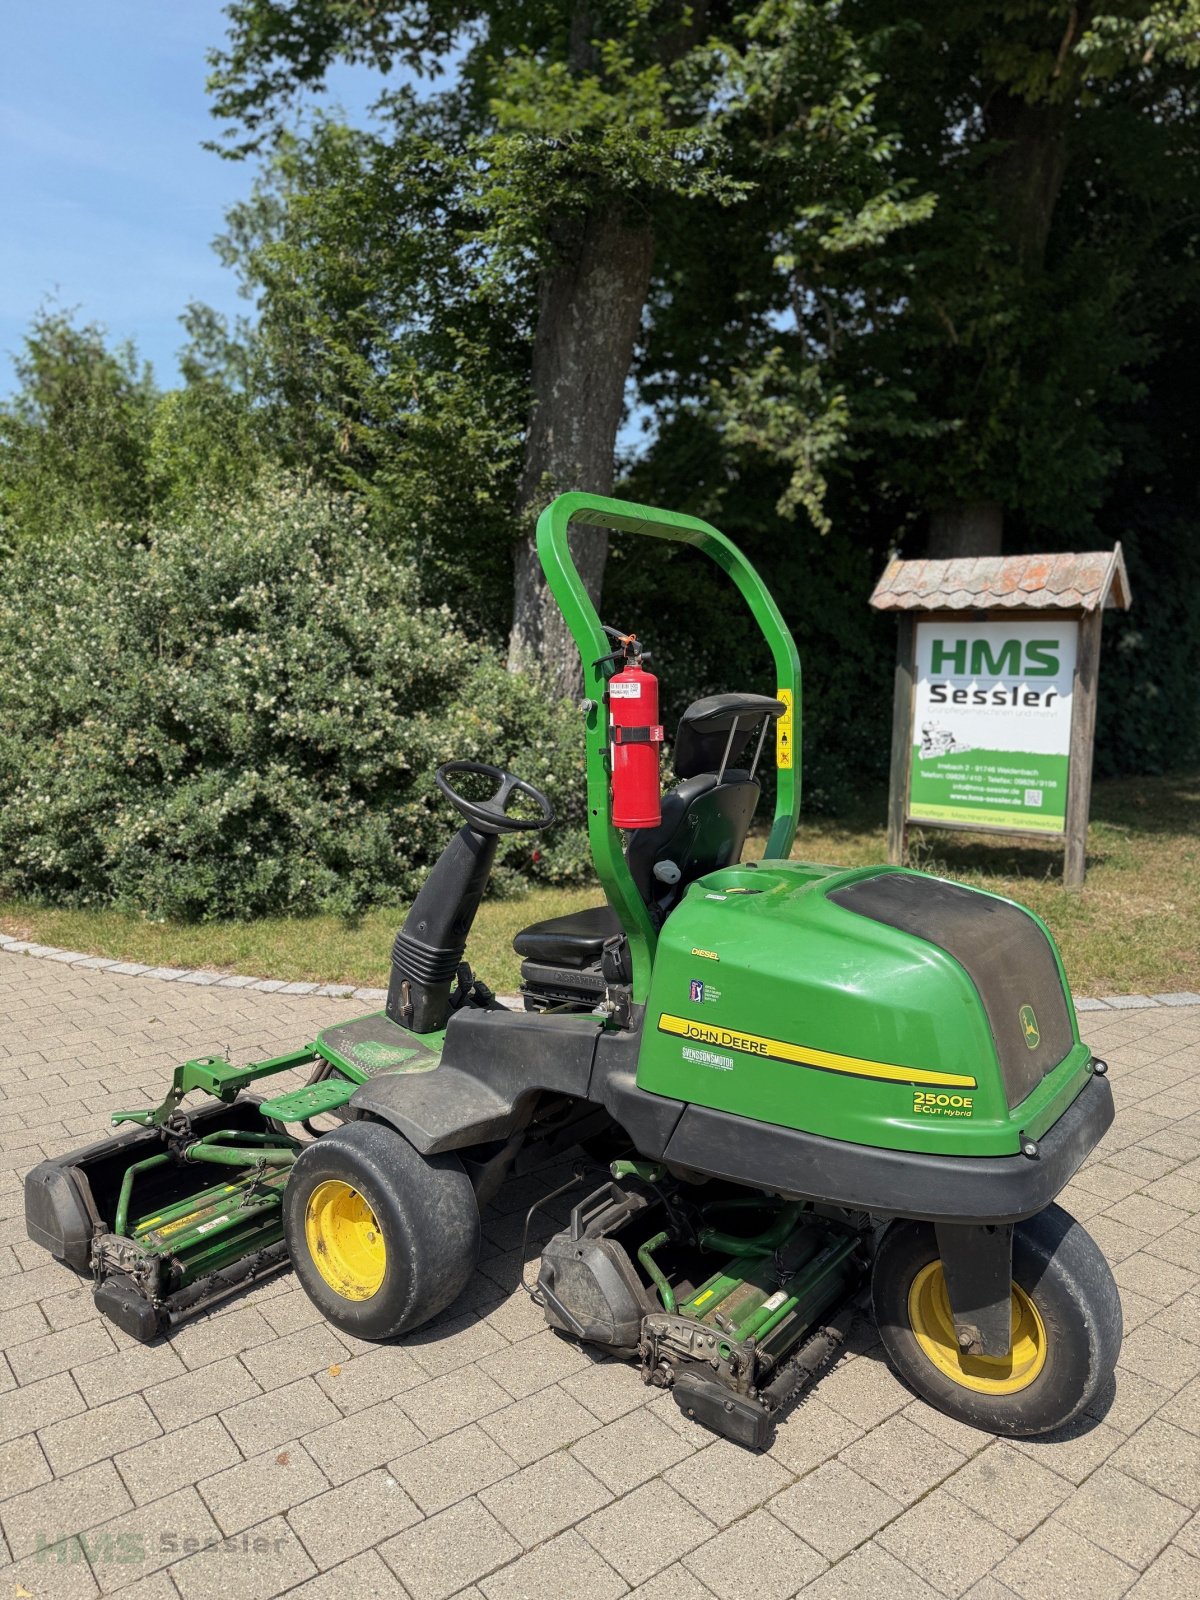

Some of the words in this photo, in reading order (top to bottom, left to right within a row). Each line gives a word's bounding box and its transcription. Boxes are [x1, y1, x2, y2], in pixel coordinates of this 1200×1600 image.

[931, 639, 1060, 677] HMS
[929, 684, 1058, 707] Sessler
[949, 793, 1022, 806] www.hms-sessler.de
[691, 947, 720, 960] DIESEL
[682, 1024, 719, 1043] JOHN
[722, 1032, 768, 1054] DEERE
[913, 1091, 973, 1108] 2500E
[943, 1109, 972, 1117] Hybrid
